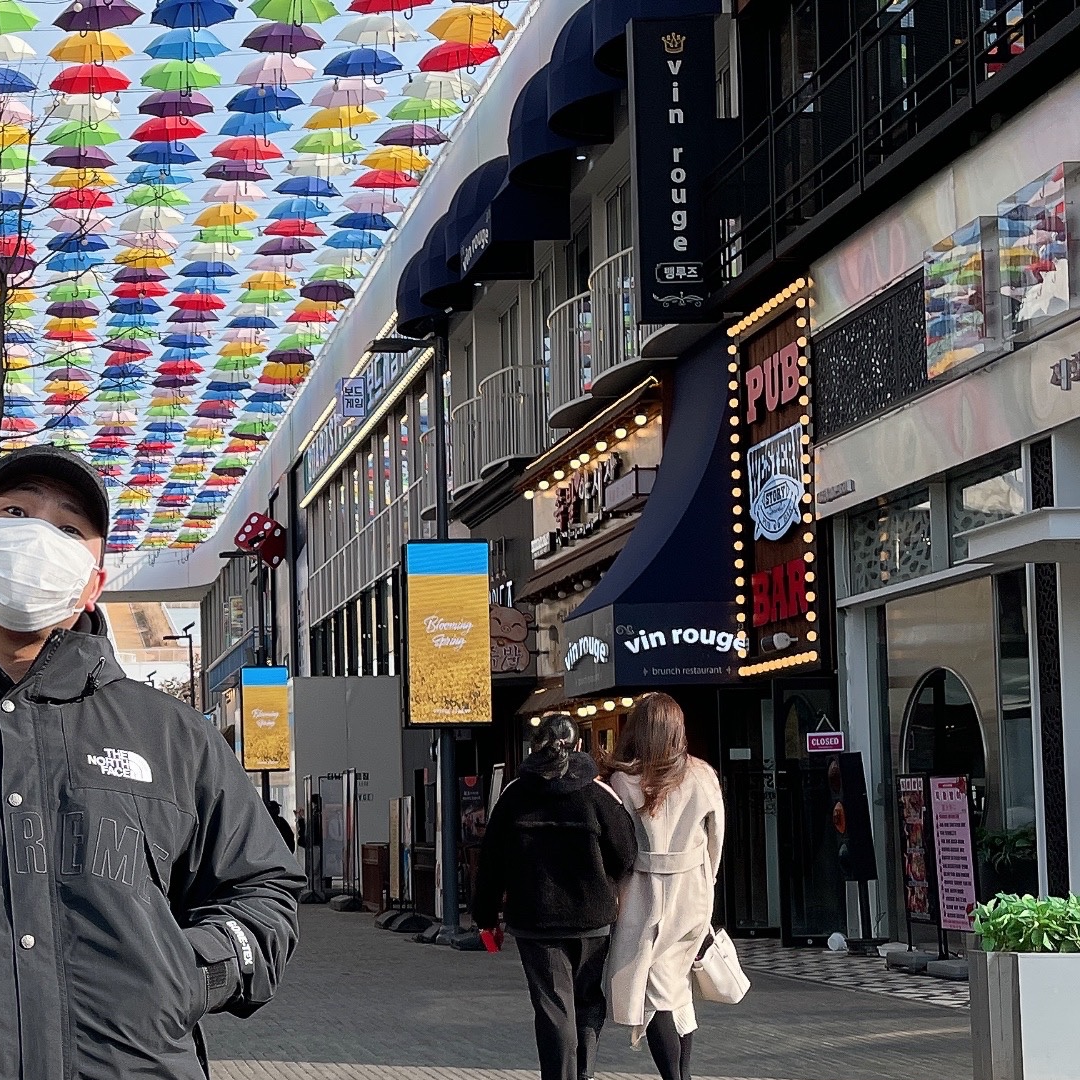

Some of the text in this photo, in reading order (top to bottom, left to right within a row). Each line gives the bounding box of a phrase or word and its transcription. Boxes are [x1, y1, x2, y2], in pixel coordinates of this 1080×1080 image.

[666, 60, 688, 252] vin rouge
[663, 266, 698, 280] 뱅루즈
[344, 386, 363, 397] 보드
[745, 341, 800, 425] PUB
[345, 398, 363, 409] 게임
[748, 425, 804, 504] WESTERN
[765, 485, 787, 506] STORY
[752, 558, 808, 628] BAR
[423, 614, 474, 635] Blooming
[431, 633, 466, 651] Spring
[624, 628, 748, 655] vin rouge
[564, 635, 609, 672] vin rouge
[652, 666, 723, 676] brunch restaurant
[811, 737, 839, 747] CLOSED
[86, 754, 130, 769] NORTH
[103, 747, 128, 760] THE
[100, 765, 131, 778] FACE
[225, 920, 254, 966] GORE-TEX
